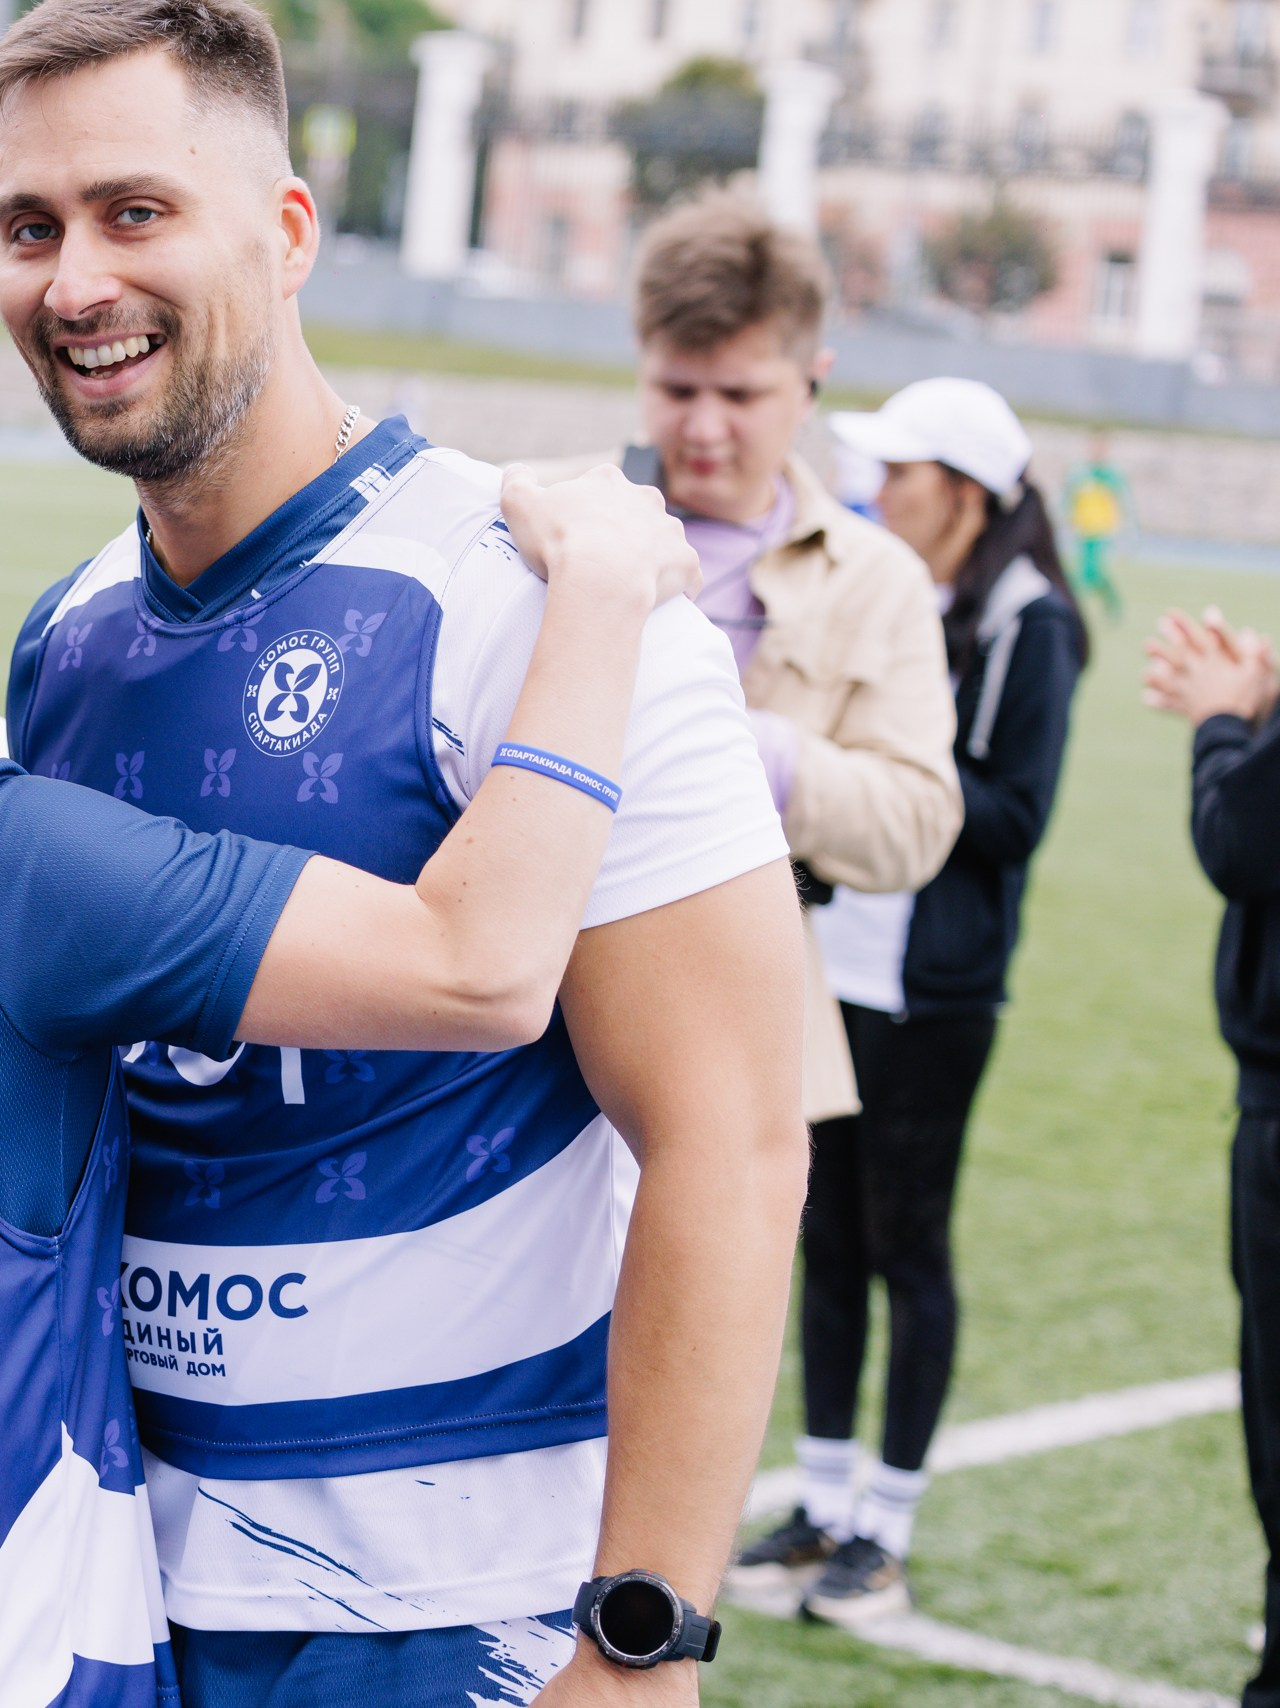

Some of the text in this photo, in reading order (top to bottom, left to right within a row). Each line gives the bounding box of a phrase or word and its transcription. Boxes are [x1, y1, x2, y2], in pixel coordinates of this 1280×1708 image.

[258, 634, 340, 674] КОМОС ГРУПП
[248, 712, 328, 751] СПАРТАКИАДА
[506, 748, 572, 777] СПАРТАКИАДА
[573, 770, 603, 791] КОМОС
[186, 1360, 227, 1378] ДОМ
